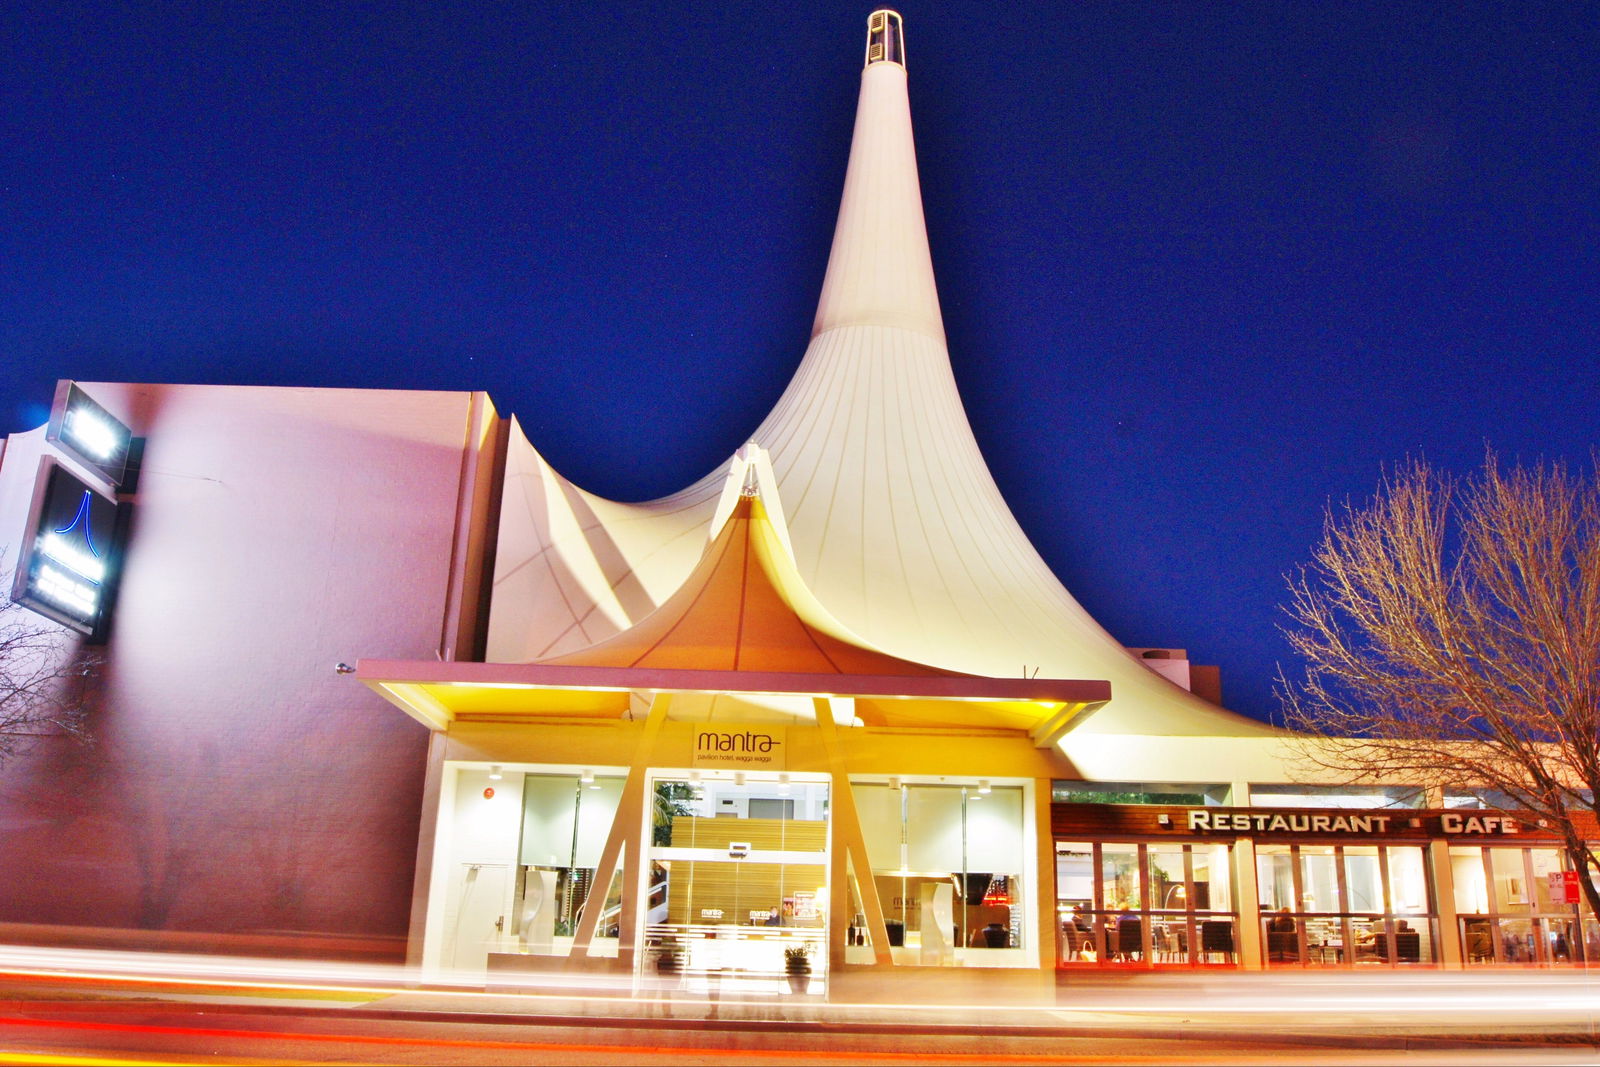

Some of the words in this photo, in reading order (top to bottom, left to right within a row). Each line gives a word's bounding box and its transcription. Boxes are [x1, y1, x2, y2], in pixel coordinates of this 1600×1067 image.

[698, 731, 781, 752] mantra
[1188, 810, 1391, 832] RESTAURANT
[1441, 814, 1519, 833] CAFE
